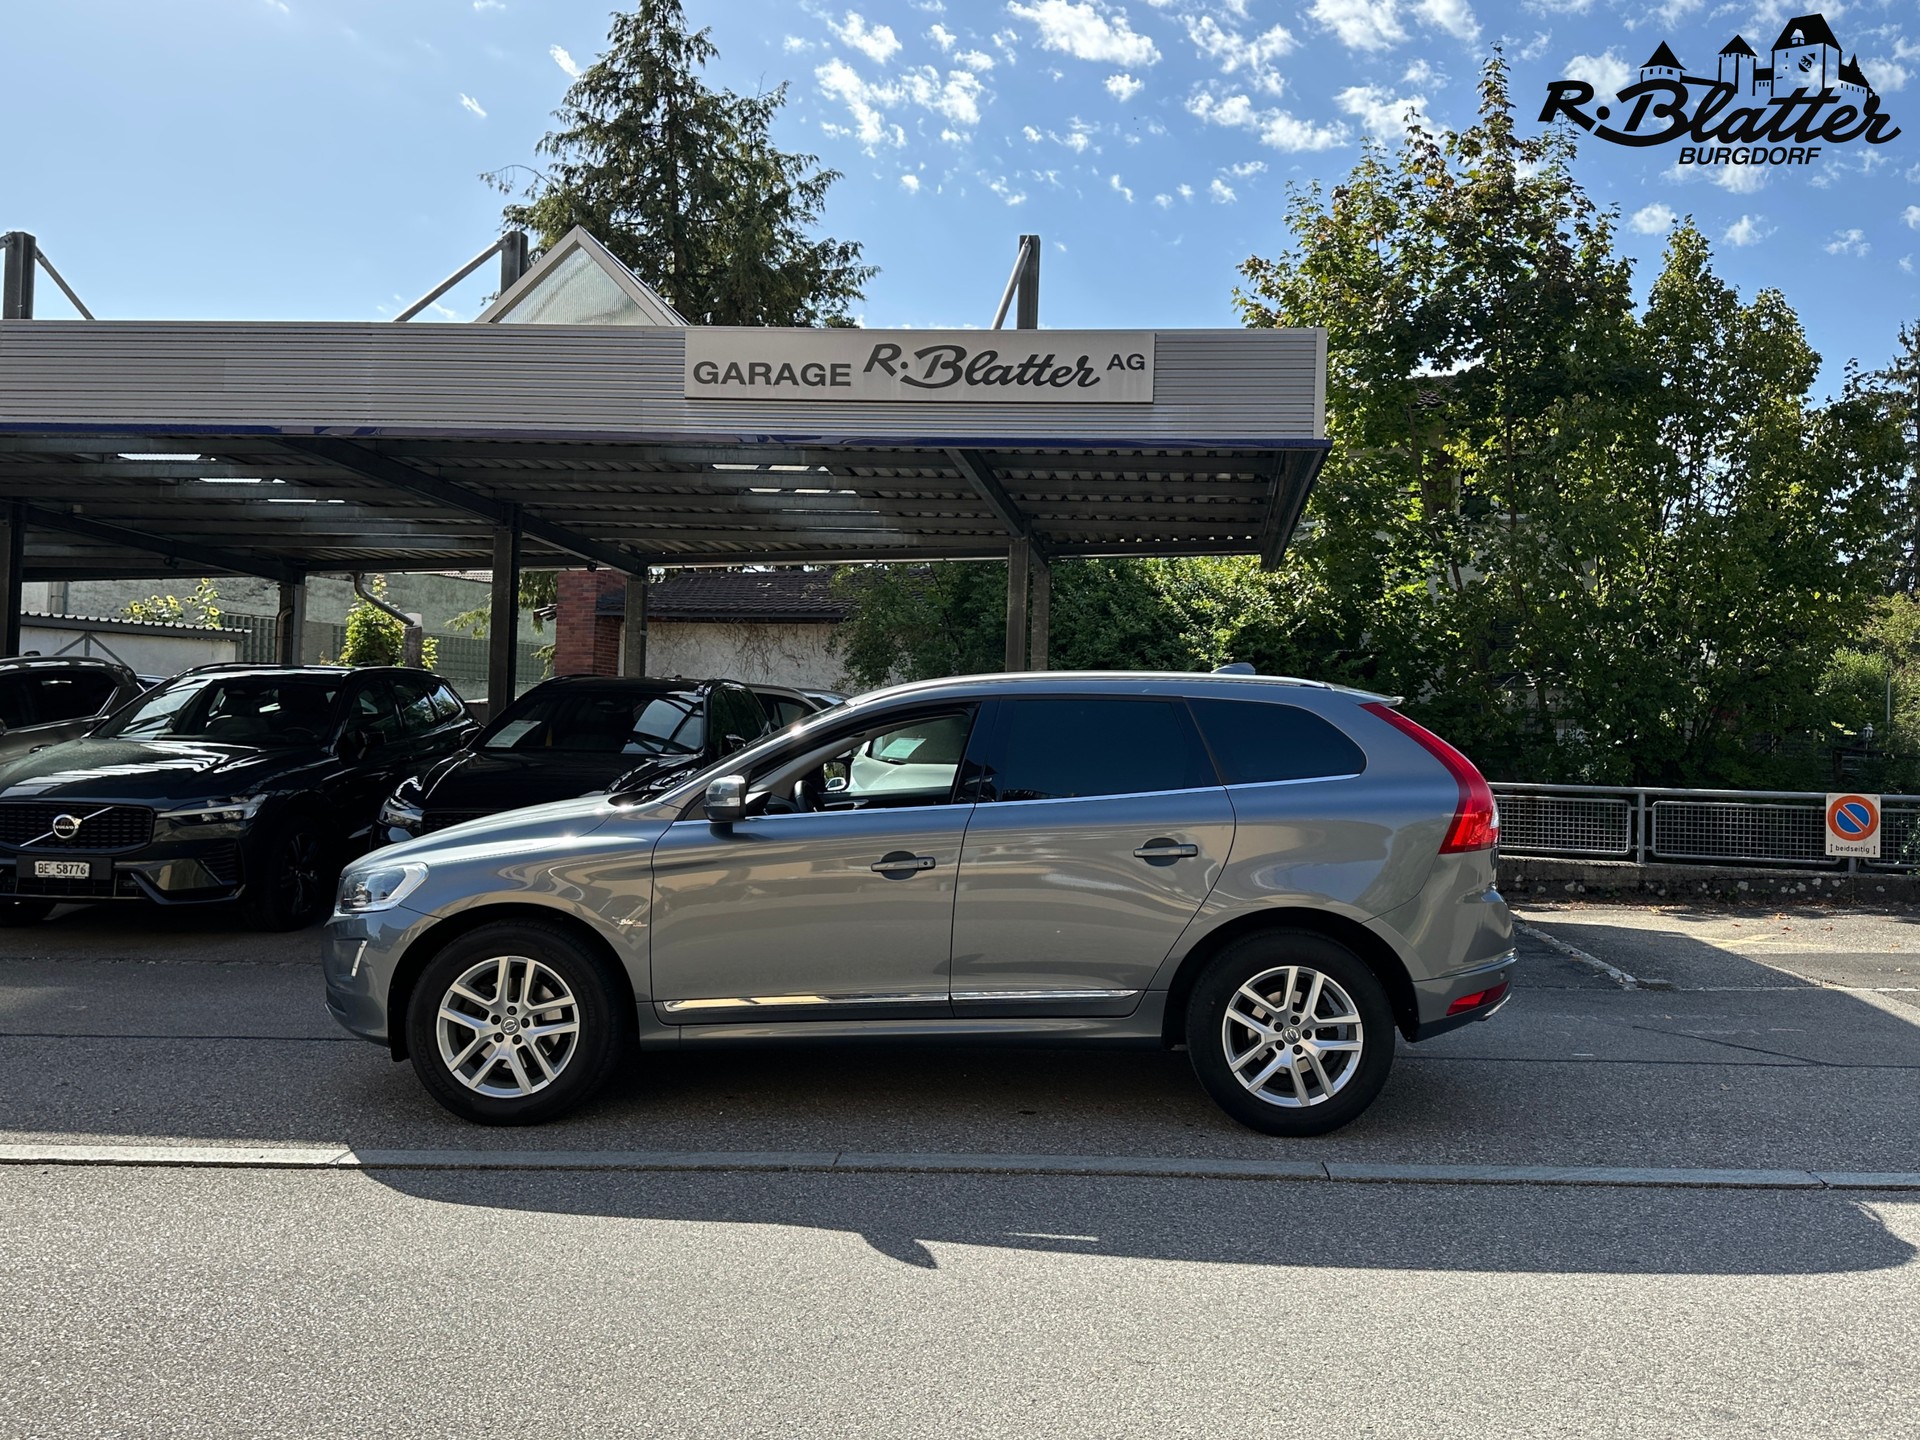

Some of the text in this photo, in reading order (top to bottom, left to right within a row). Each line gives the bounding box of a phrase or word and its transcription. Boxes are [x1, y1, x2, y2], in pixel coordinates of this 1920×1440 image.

[693, 361, 852, 387] GARAGE
[1106, 353, 1146, 371] AG
[1835, 845, 1870, 854] beidseitig
[38, 863, 86, 875] BE 58776
